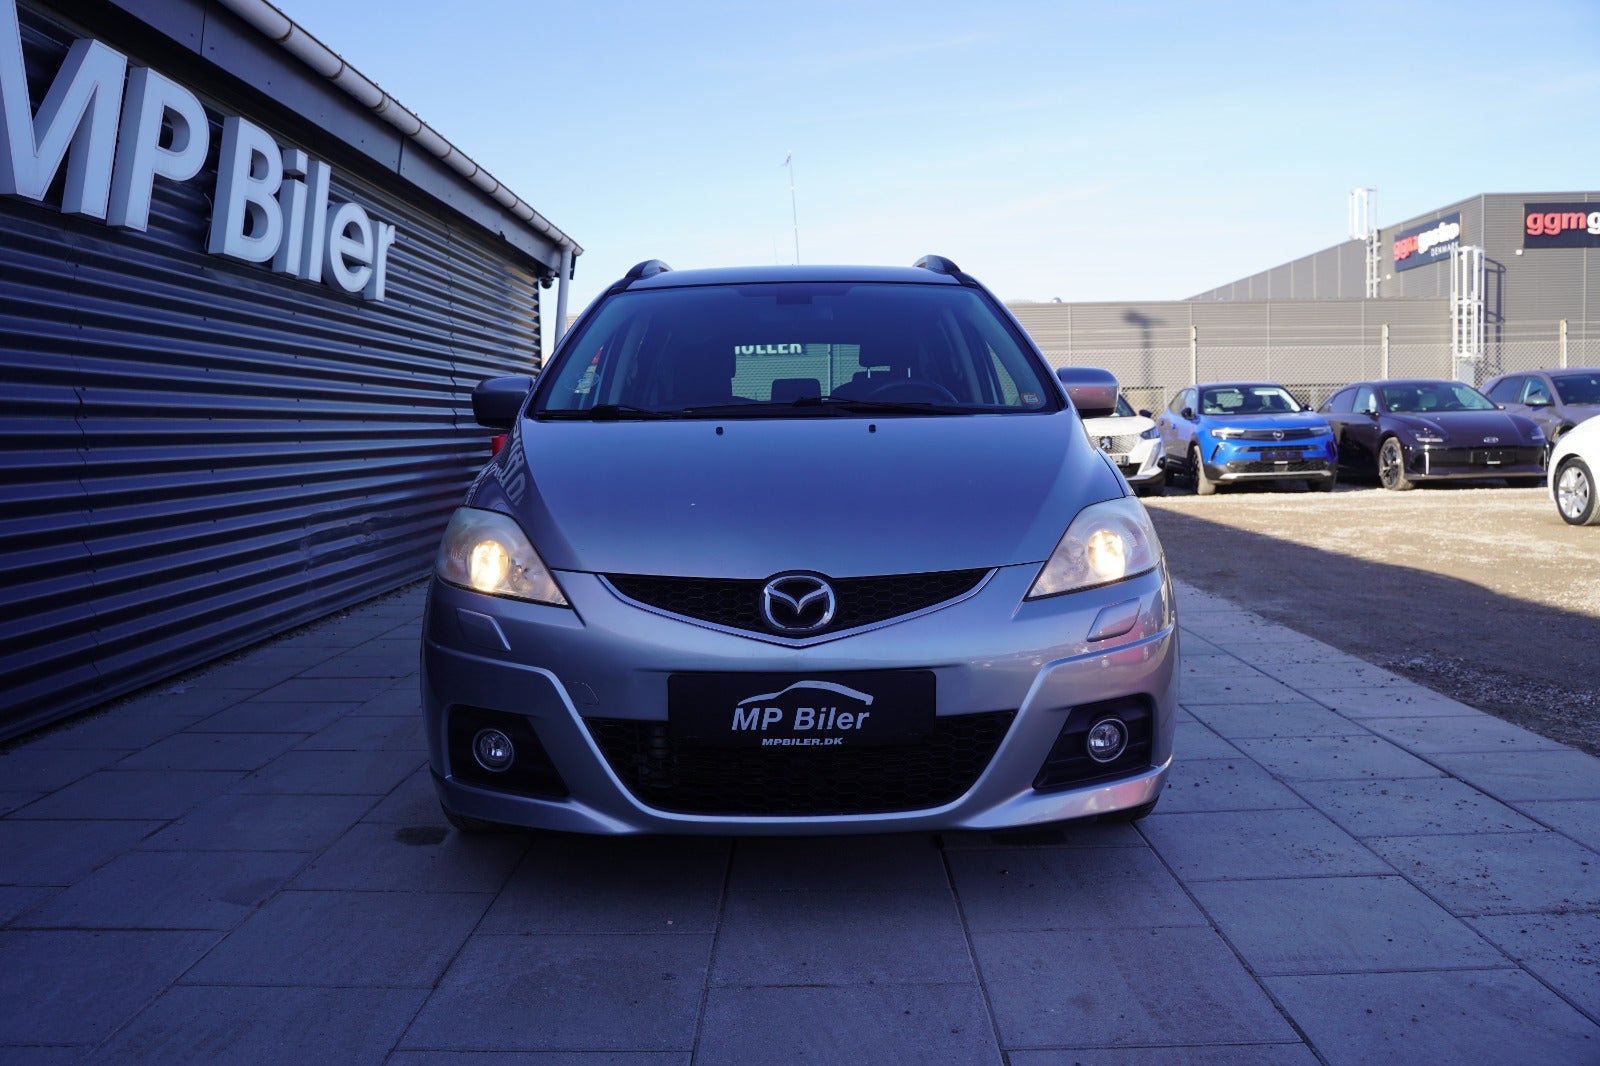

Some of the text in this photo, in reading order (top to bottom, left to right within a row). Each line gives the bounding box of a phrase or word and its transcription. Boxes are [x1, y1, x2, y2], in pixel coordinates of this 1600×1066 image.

[0, 0, 396, 301] MP Biler
[731, 707, 870, 731] MP Biler
[761, 737, 843, 746] MPBILER.DK
